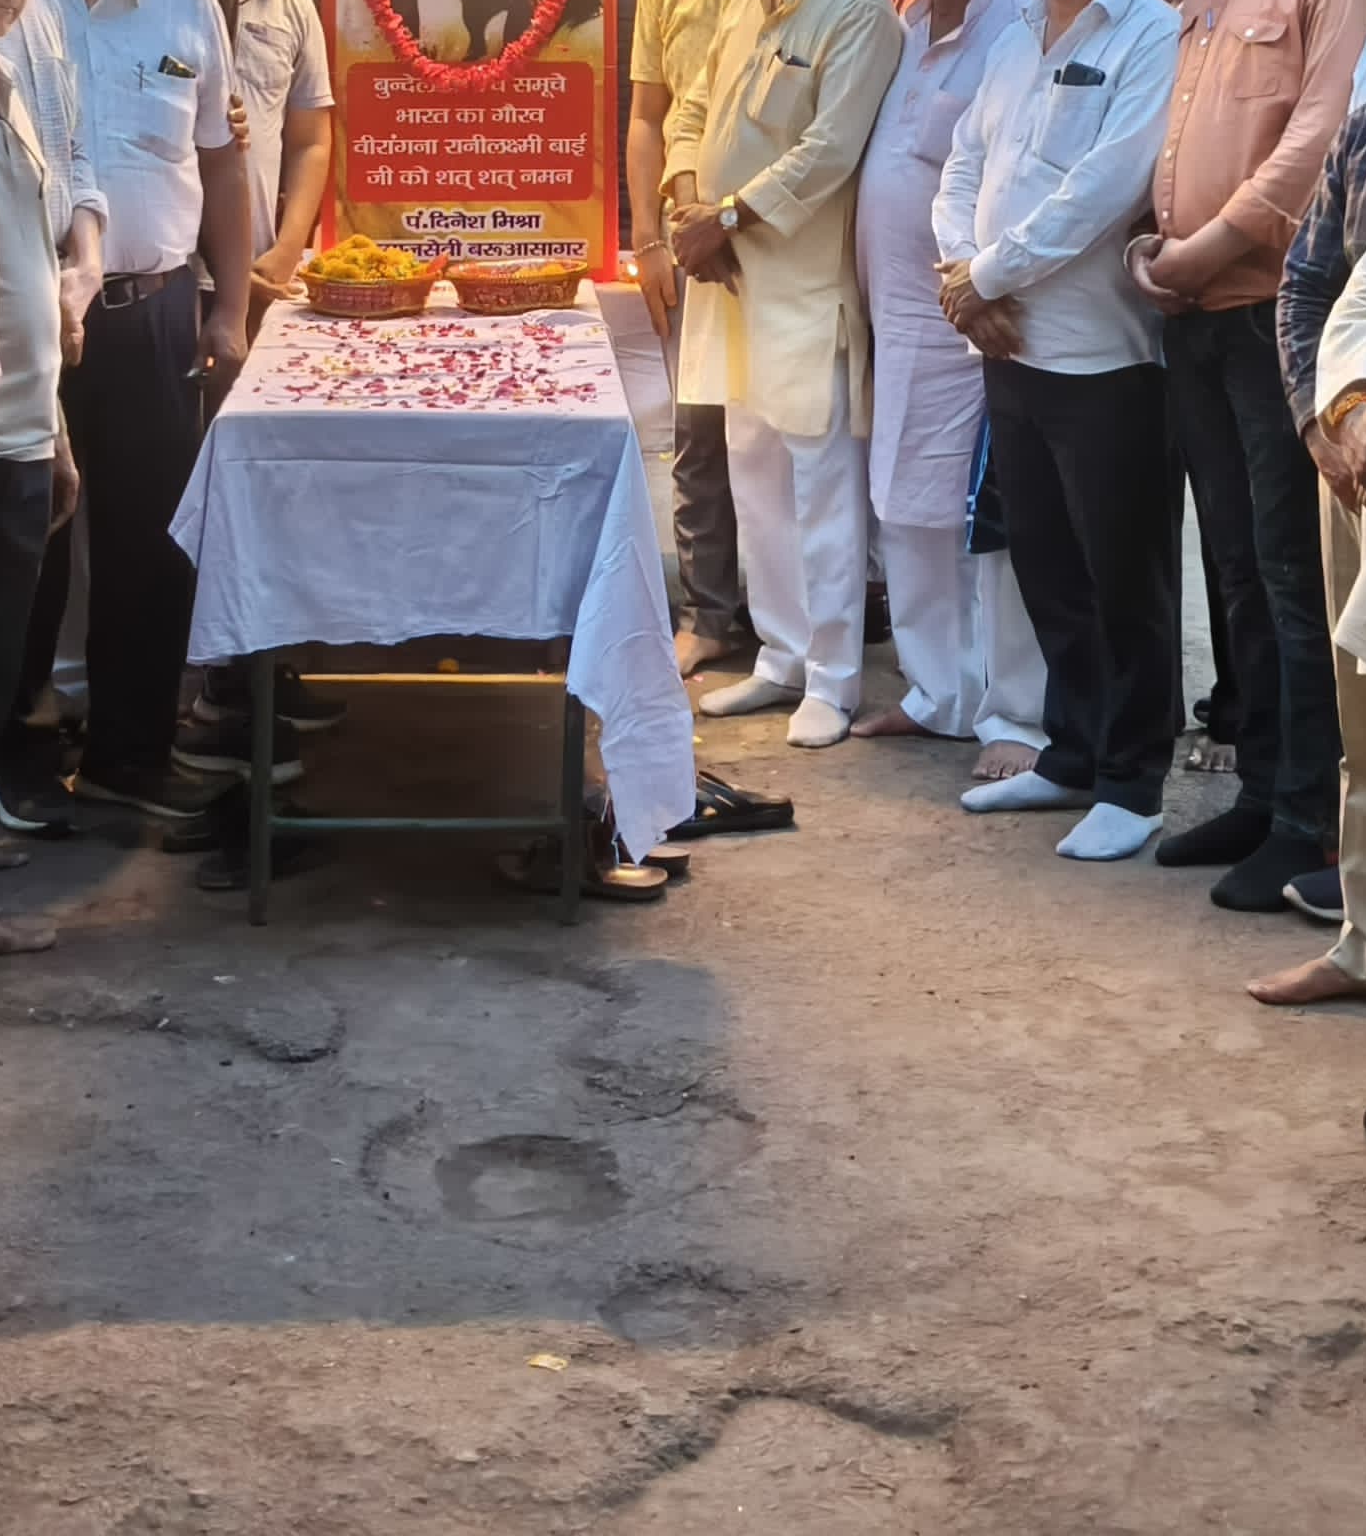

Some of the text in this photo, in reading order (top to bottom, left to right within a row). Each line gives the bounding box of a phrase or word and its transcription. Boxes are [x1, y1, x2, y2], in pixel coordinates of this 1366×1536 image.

[395, 102, 547, 125] भारत का गौरव
[352, 132, 439, 157] वीरांगना
[548, 131, 588, 157] बाई
[365, 165, 575, 191] जी को शत् शत् नमन
[491, 210, 542, 230] मिश्रा
